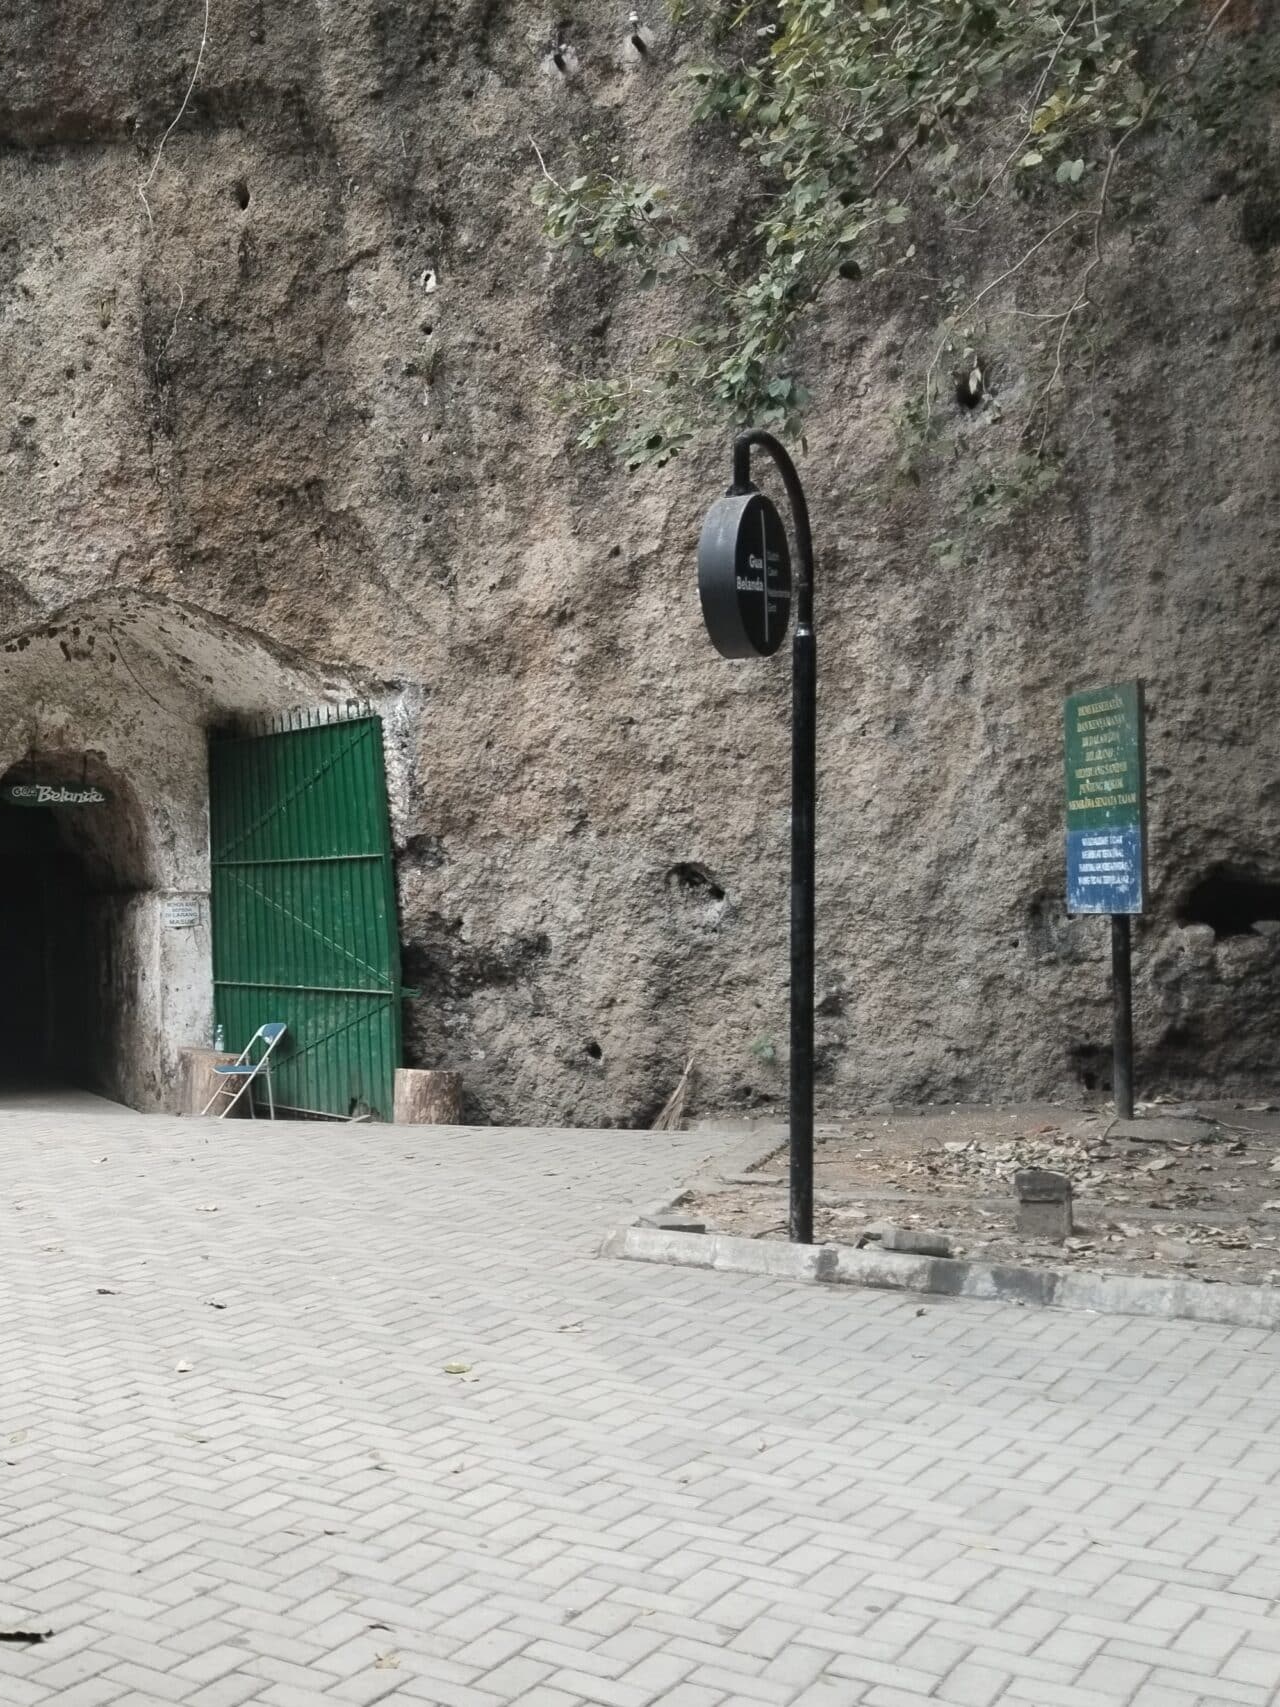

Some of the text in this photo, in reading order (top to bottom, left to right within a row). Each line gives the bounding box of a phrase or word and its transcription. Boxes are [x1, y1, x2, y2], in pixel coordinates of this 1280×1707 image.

[749, 553, 763, 569] Gua
[736, 575, 764, 592] Belanda
[36, 784, 104, 803] Belanda
